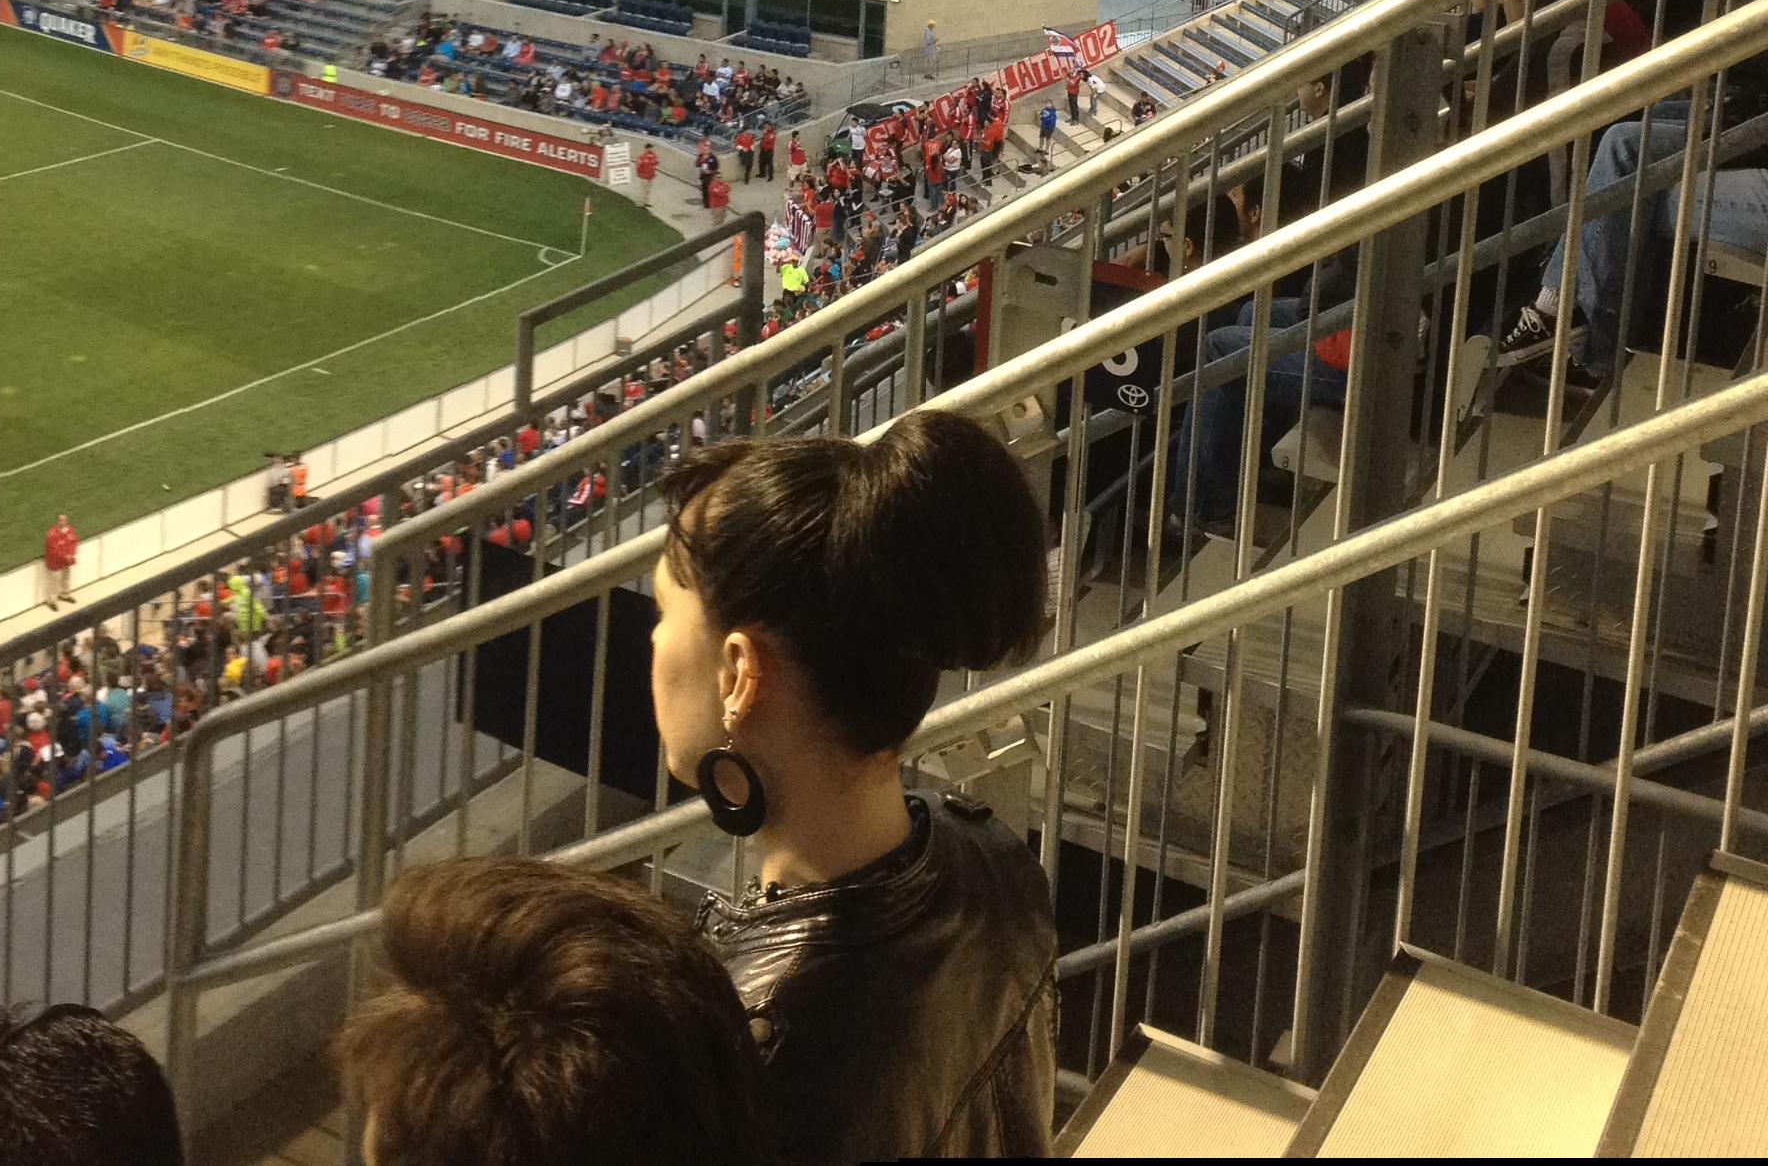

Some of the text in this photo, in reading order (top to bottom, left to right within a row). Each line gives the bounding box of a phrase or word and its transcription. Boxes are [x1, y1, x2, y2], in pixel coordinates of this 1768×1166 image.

[38, 12, 97, 45] QUAKER
[454, 122, 491, 142] FOR
[494, 131, 532, 153] FIRE
[536, 142, 600, 169] ALERTS
